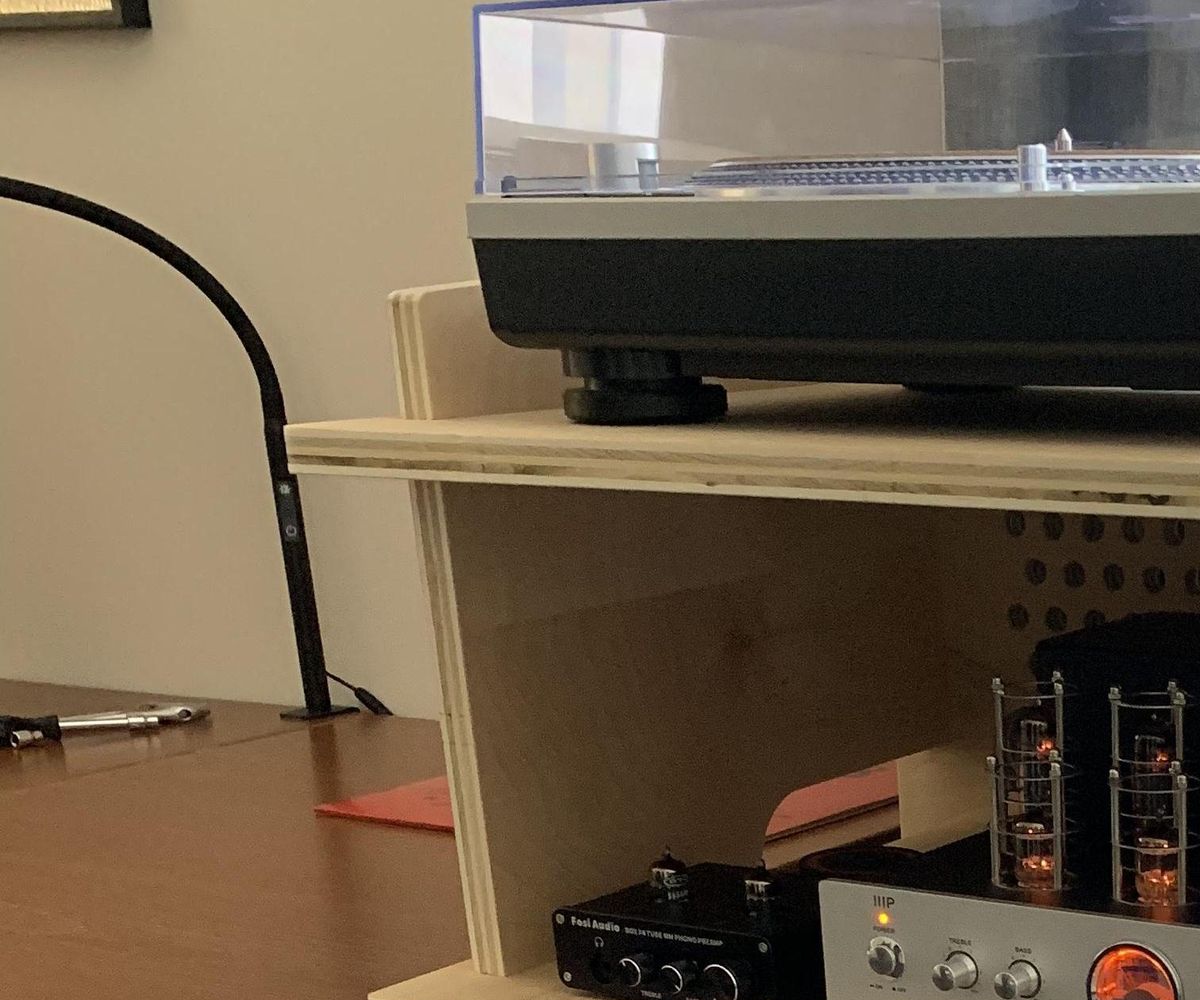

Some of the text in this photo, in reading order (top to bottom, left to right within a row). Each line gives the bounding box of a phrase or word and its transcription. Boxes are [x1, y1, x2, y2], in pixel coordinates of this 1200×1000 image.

[570, 916, 591, 928] Fosi
[592, 919, 620, 932] Audio
[948, 937, 972, 946] TREBLE
[1014, 946, 1032, 955] BASS
